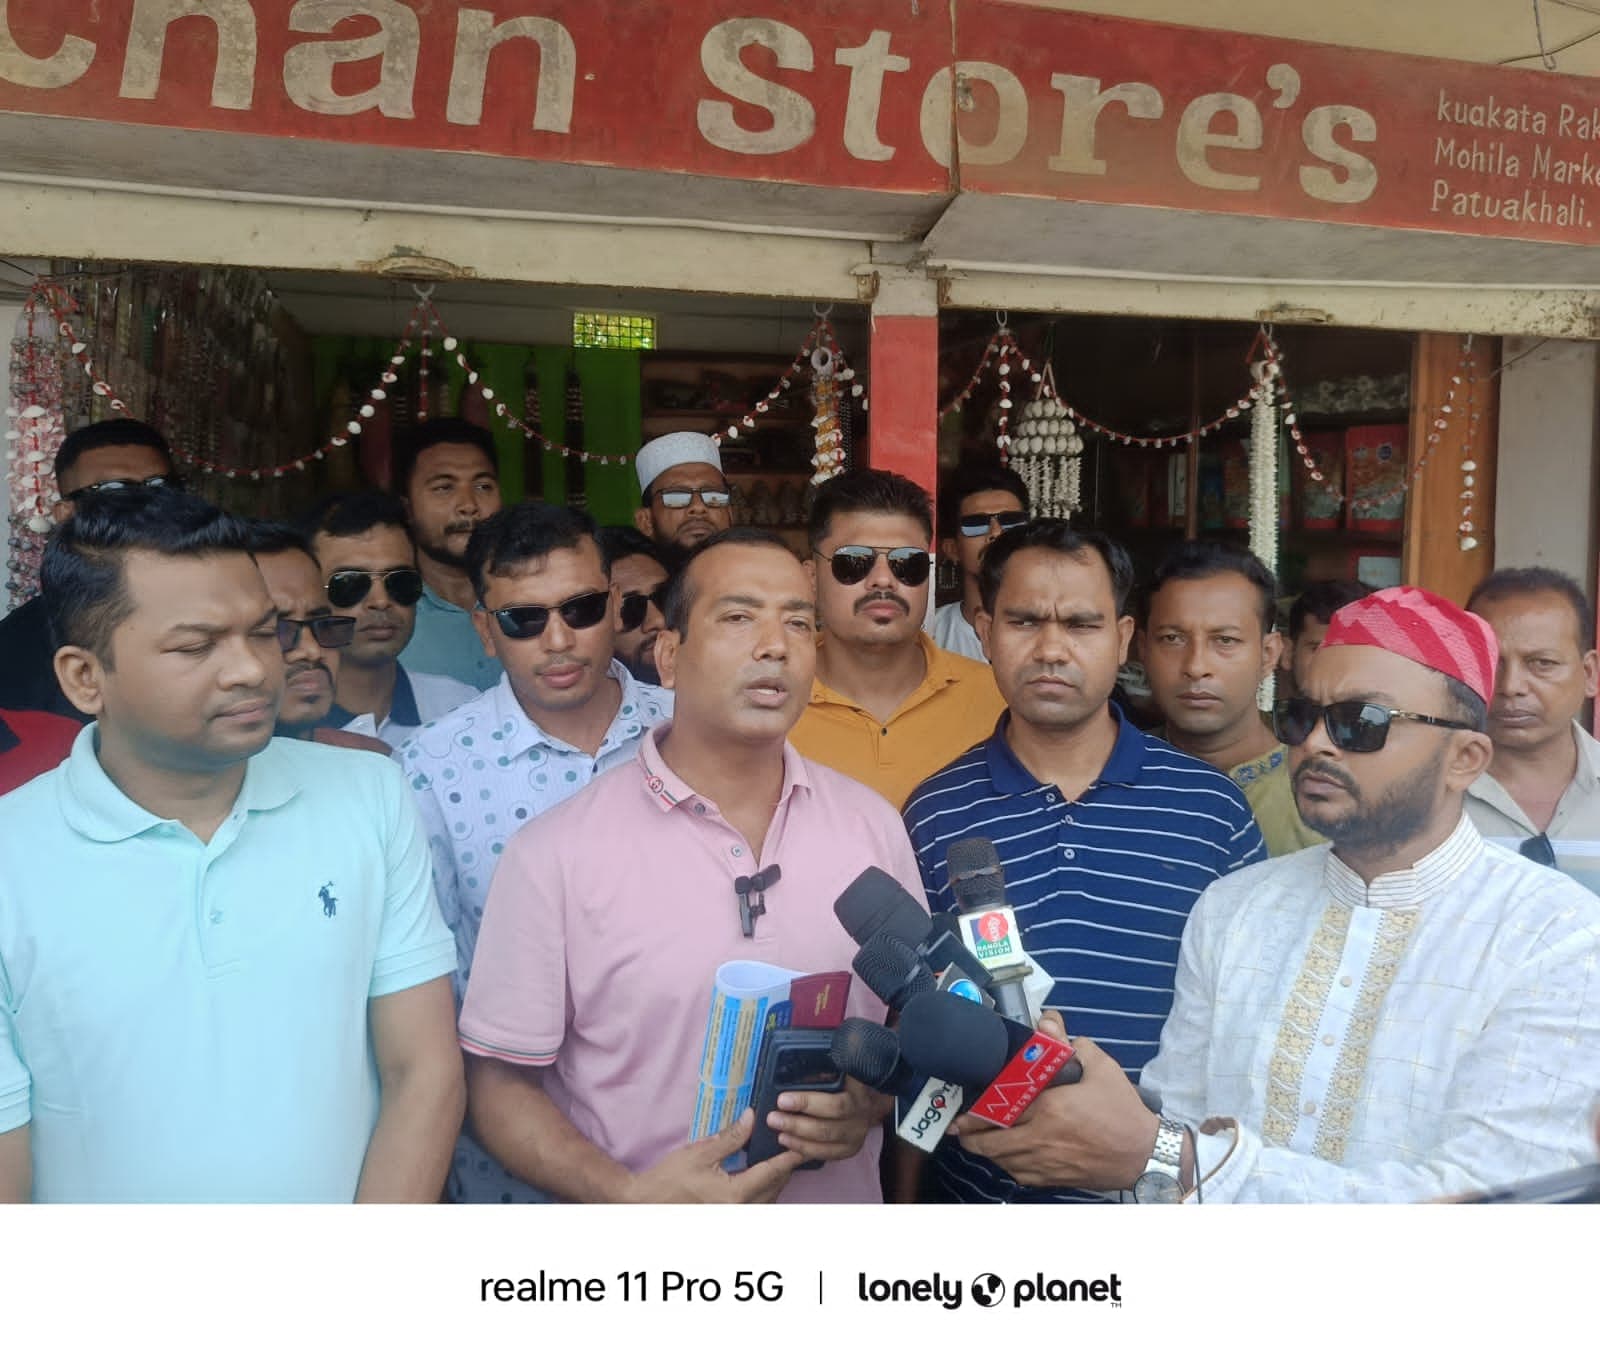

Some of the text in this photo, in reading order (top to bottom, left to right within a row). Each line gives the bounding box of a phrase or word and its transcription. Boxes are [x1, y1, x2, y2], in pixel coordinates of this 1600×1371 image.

[696, 17, 1378, 203] Store's
[1434, 137, 1520, 178] Mohila
[1430, 179, 1593, 228] Patuakhali.
